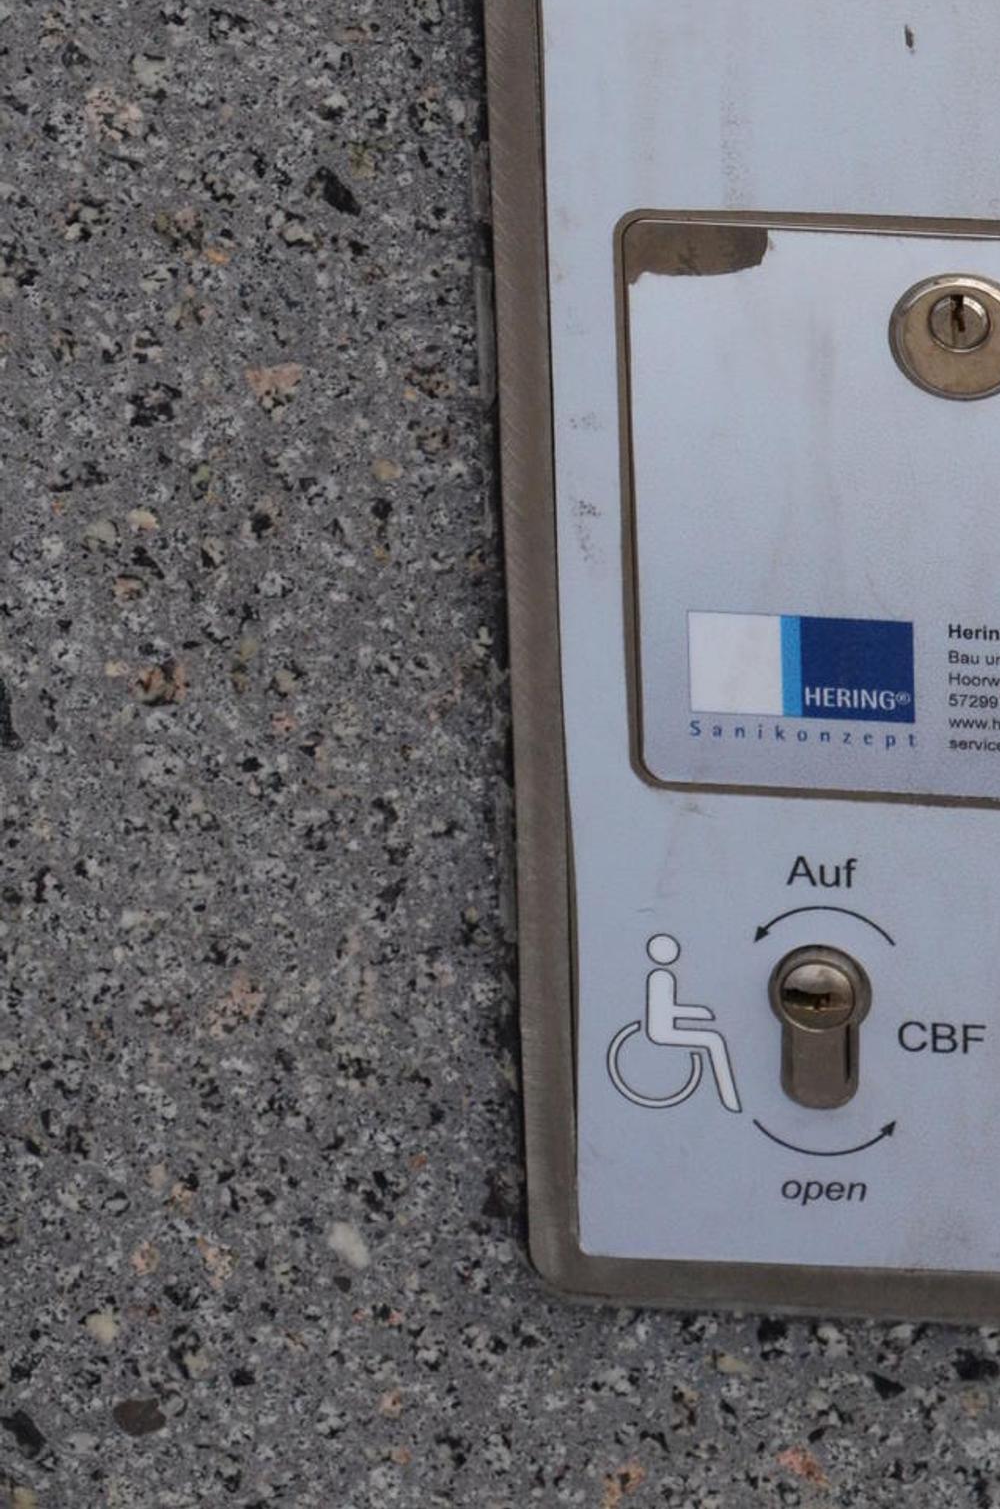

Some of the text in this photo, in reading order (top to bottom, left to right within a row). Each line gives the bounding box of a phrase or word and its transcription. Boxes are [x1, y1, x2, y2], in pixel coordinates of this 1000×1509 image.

[948, 649, 980, 665] Bau
[948, 693, 999, 709] 57299
[787, 855, 858, 888] Auf
[897, 1020, 987, 1054] CBF
[780, 1180, 867, 1206] open
